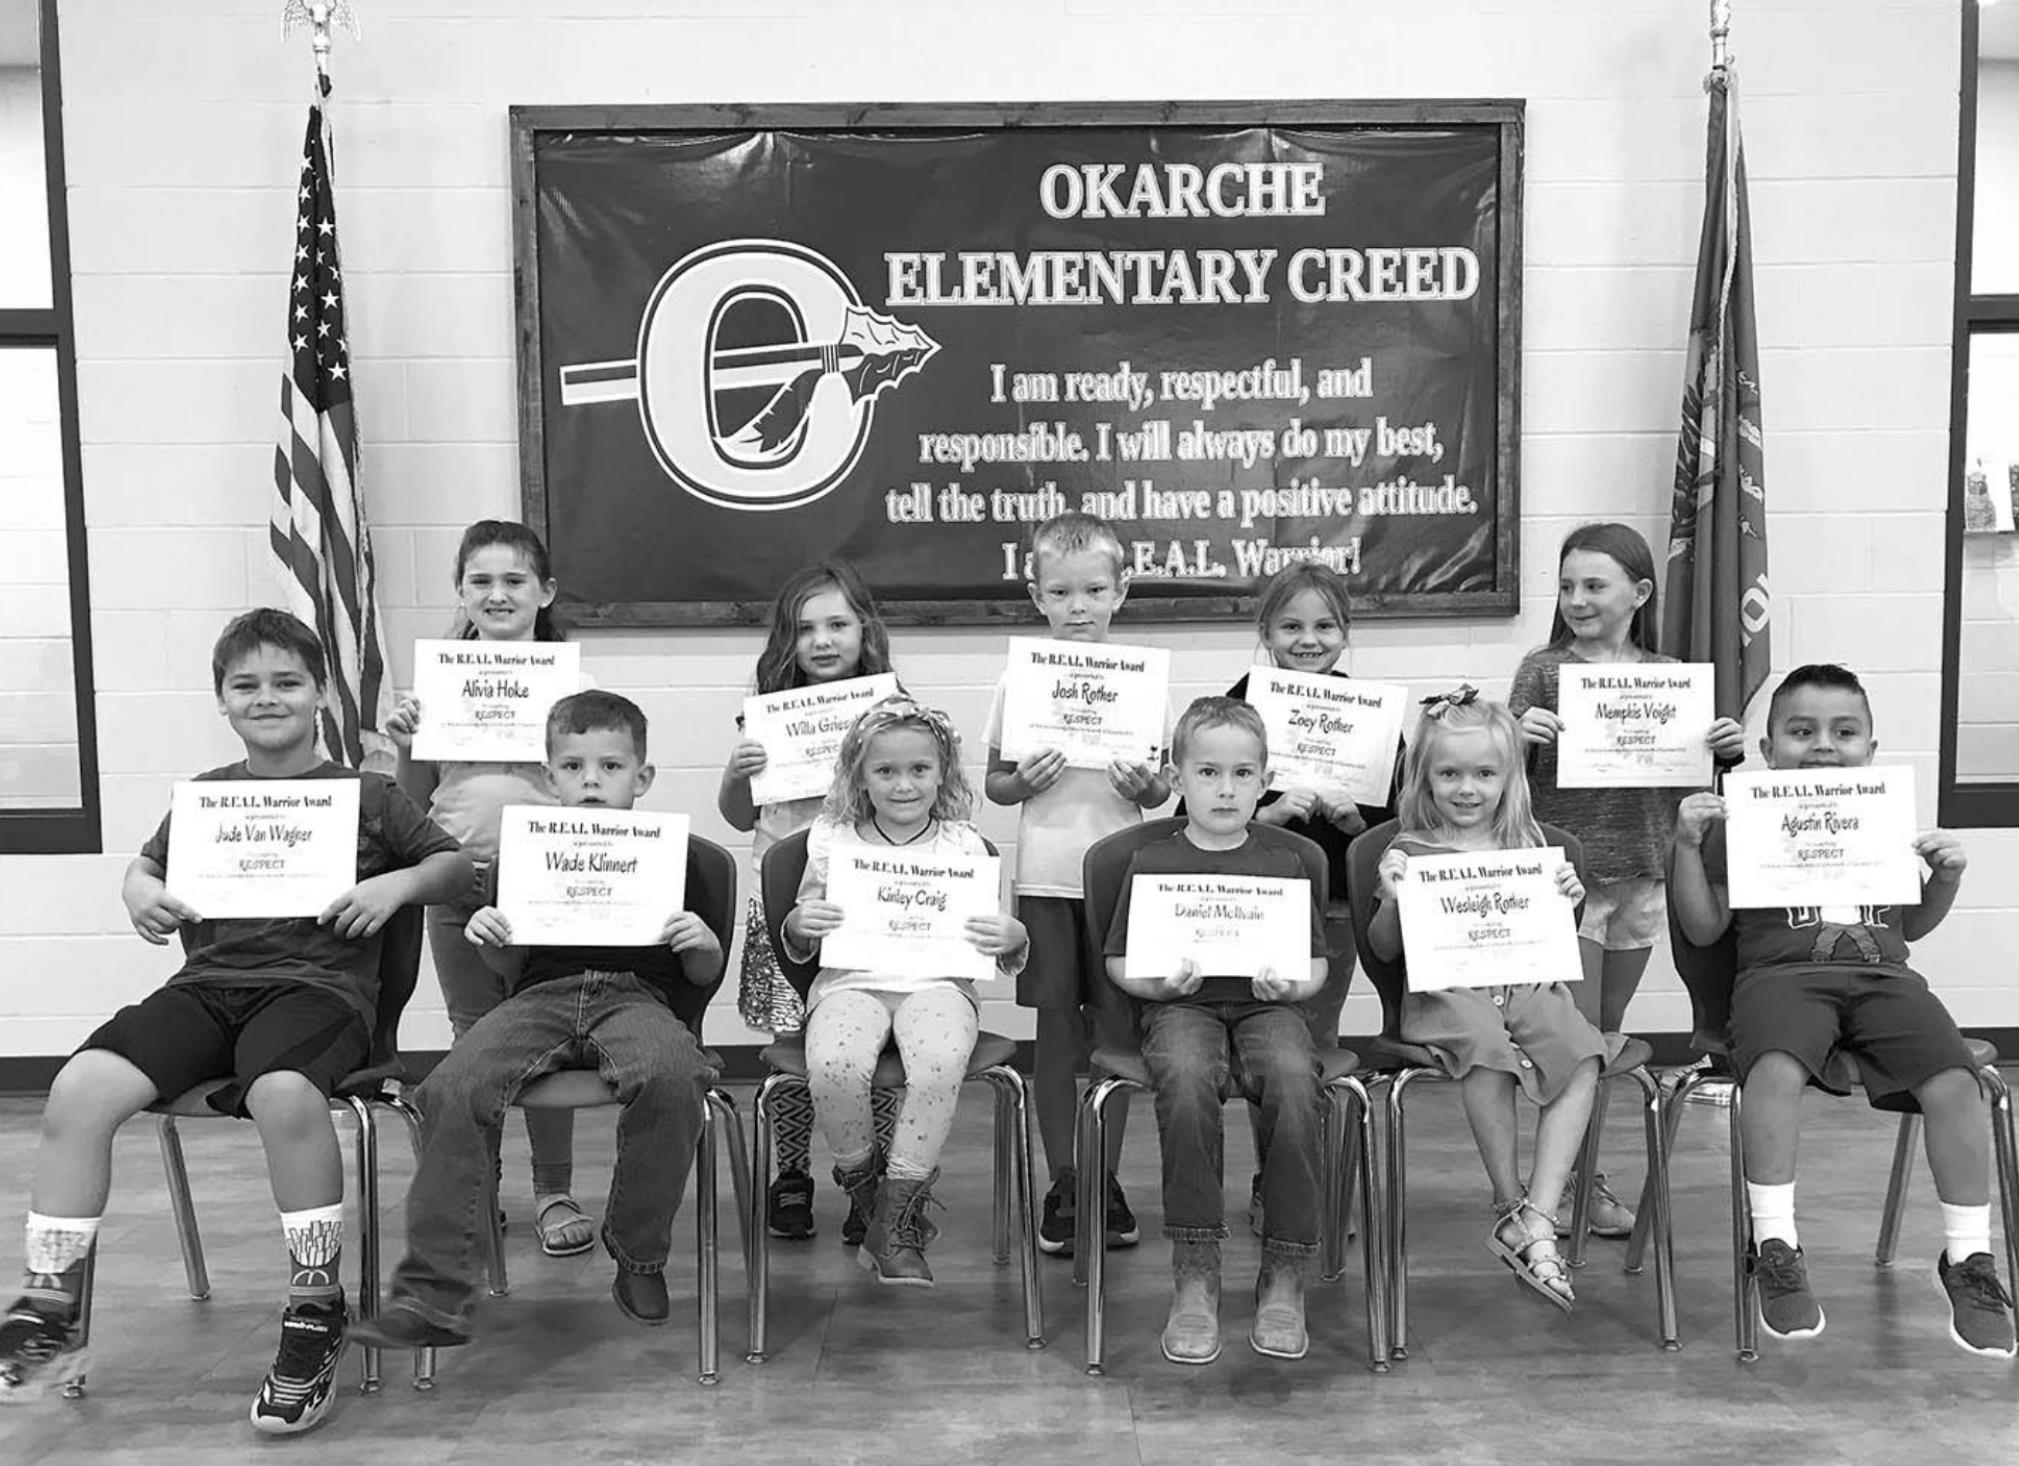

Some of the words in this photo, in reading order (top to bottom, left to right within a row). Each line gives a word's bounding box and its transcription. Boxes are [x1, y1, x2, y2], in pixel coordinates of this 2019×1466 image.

[1039, 162, 1326, 218] OKARCHE
[883, 248, 1277, 306] ELEMENTARY
[1287, 246, 1479, 302] CREED
[990, 363, 1007, 402] I
[1012, 372, 1060, 402] am
[1064, 361, 1154, 411] ready,
[1160, 358, 1311, 411] respectful,
[1316, 357, 1373, 398] and
[918, 421, 1090, 473] responsible.
[1095, 422, 1112, 461] I
[1115, 420, 1172, 461] will
[1177, 419, 1275, 469] always
[1280, 417, 1319, 458] do
[1323, 428, 1372, 467] my
[1375, 416, 1444, 464] best,
[884, 482, 934, 523] tell
[937, 482, 986, 522] the
[1081, 480, 1137, 520] and
[1141, 480, 1211, 520] have
[1216, 489, 1236, 519] a
[1240, 476, 1352, 528] positive
[1356, 474, 1478, 516] attitude.
[1002, 542, 1018, 580] I
[438, 653, 454, 665] The
[494, 654, 527, 665] Warrior
[531, 655, 555, 665] Award
[1031, 652, 1047, 664] The
[1086, 656, 1117, 670] Warrior
[1121, 660, 1145, 672] Award
[462, 679, 493, 698] Alivia
[497, 679, 529, 698] Hoke
[1052, 679, 1078, 699] Josh
[1082, 682, 1118, 705] Rother
[1581, 678, 1596, 689] The
[1634, 677, 1665, 688] Warrior
[1668, 678, 1691, 689] Award
[766, 704, 779, 713] The
[817, 694, 847, 705] Warrior
[851, 688, 874, 699] Award
[1270, 681, 1285, 693] The
[1323, 689, 1355, 703] Warrior
[1358, 694, 1382, 708] Award
[475, 711, 515, 721] RESPECT
[1064, 714, 1102, 725] RESPECT
[1288, 709, 1317, 733] Zoey
[1319, 713, 1354, 734] Rother
[1595, 702, 1641, 725] Memphis
[1297, 743, 1336, 756] RESPECT
[1617, 736, 1656, 746] RESPECT
[1751, 787, 1770, 799] The
[1815, 784, 1853, 796] Warrior
[1856, 782, 1886, 794] Award
[199, 797, 217, 808] The
[263, 796, 301, 807] Warrior
[304, 795, 332, 807] Award
[528, 821, 546, 834] The
[592, 823, 629, 836] Warrior
[633, 826, 660, 838] Award
[1781, 812, 1822, 838] Agustin
[1825, 811, 1859, 834] Rivera
[215, 824, 241, 843] Jude
[245, 824, 266, 842] Van
[270, 824, 312, 848] Wagner
[545, 851, 584, 872] Wade
[588, 851, 638, 874] Klinnert
[1798, 848, 1844, 861] RESPECT
[239, 860, 285, 871] RESPECT
[853, 858, 871, 871] The
[911, 865, 945, 877] Warrior
[948, 868, 974, 878] Award
[1418, 871, 1437, 882] The
[1478, 866, 1513, 878] Warrior
[1516, 863, 1542, 876] Award
[567, 886, 612, 898] RESPECT
[877, 886, 913, 911] Kinley
[915, 890, 947, 911] Craig
[1158, 884, 1173, 892] The
[1217, 885, 1252, 895] Warrior
[1256, 887, 1283, 896] Award
[1175, 903, 1211, 918] Daniel
[1440, 894, 1492, 918] Wesleigh
[1493, 892, 1529, 914] Rother
[1468, 928, 1511, 942] RESPECT
